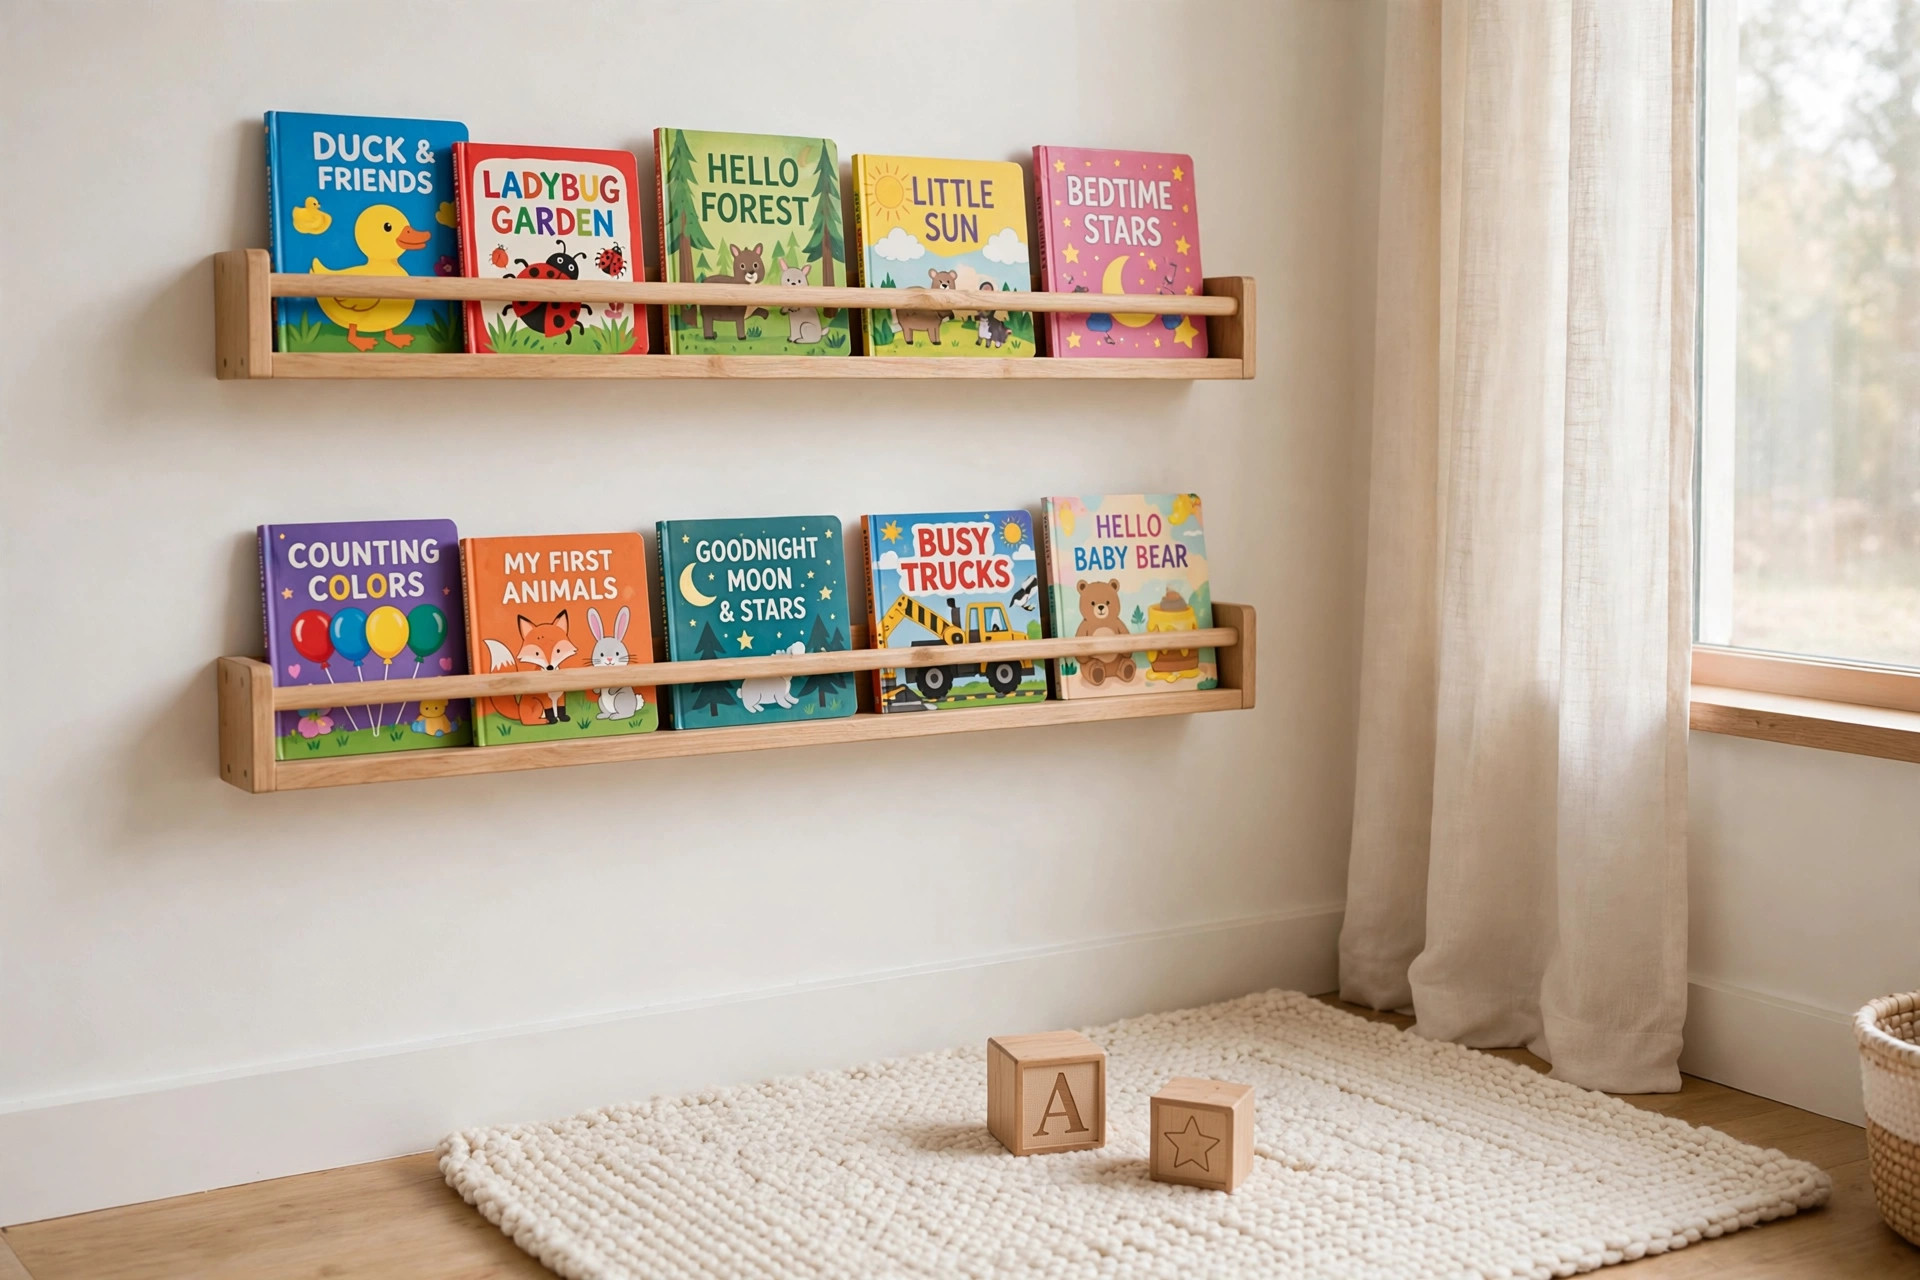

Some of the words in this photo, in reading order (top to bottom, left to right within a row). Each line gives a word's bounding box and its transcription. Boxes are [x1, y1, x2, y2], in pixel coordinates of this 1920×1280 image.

[312, 131, 406, 164] DUCK
[415, 138, 436, 164] &
[317, 165, 434, 195] FRIENDS
[707, 151, 800, 189] HELLO
[483, 169, 620, 204] LADYBUG
[912, 175, 995, 210] LITTLE
[1066, 175, 1173, 212] BEDTIME
[491, 205, 615, 238] GARDEN
[700, 191, 809, 227] FOREST
[925, 212, 980, 244] SUN
[1083, 212, 1162, 248] STARS
[1095, 513, 1162, 540] HELLO
[288, 537, 440, 569] COUNTING
[695, 536, 818, 564] GOODNIGHT
[918, 526, 991, 560] BUSY
[1074, 544, 1128, 572] BABY
[1135, 542, 1188, 570] BEAR
[504, 551, 540, 576] MY
[548, 549, 613, 574] FIRST
[900, 559, 1011, 592] TRUCKS
[308, 571, 425, 602] COLORS
[502, 576, 619, 606] ANIMALS
[727, 567, 793, 593] MOON
[718, 598, 735, 622] &
[740, 596, 807, 622] STARS
[1032, 1072, 1090, 1137] A
